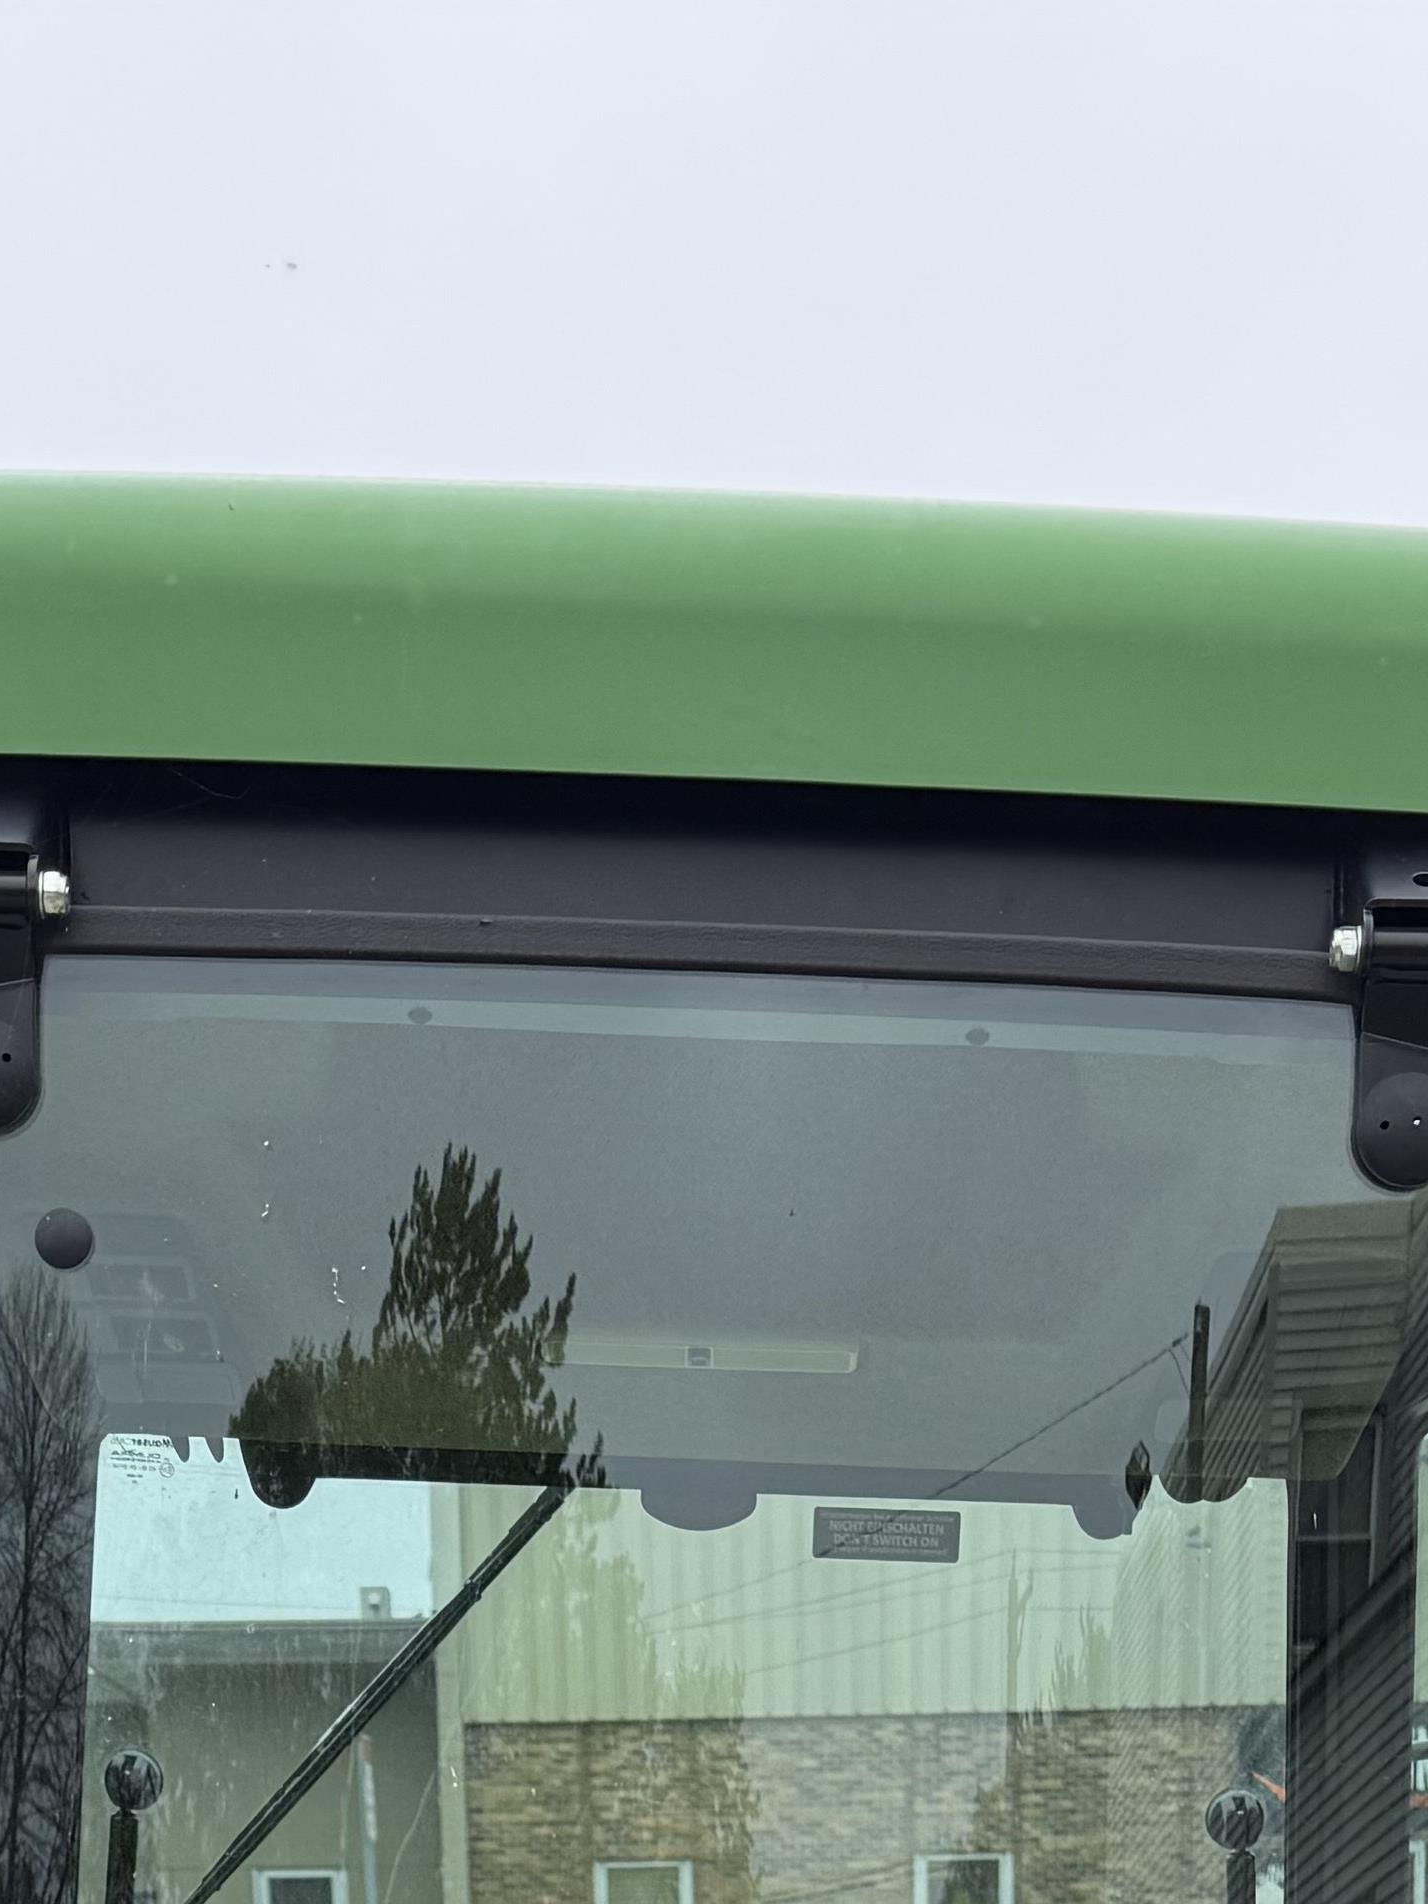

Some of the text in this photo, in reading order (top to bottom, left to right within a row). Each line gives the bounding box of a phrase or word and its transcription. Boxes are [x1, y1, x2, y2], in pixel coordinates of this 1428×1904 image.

[829, 1519, 863, 1532] NICHT
[873, 1535, 918, 1547] SWITCH
[921, 1537, 939, 1548] ON
